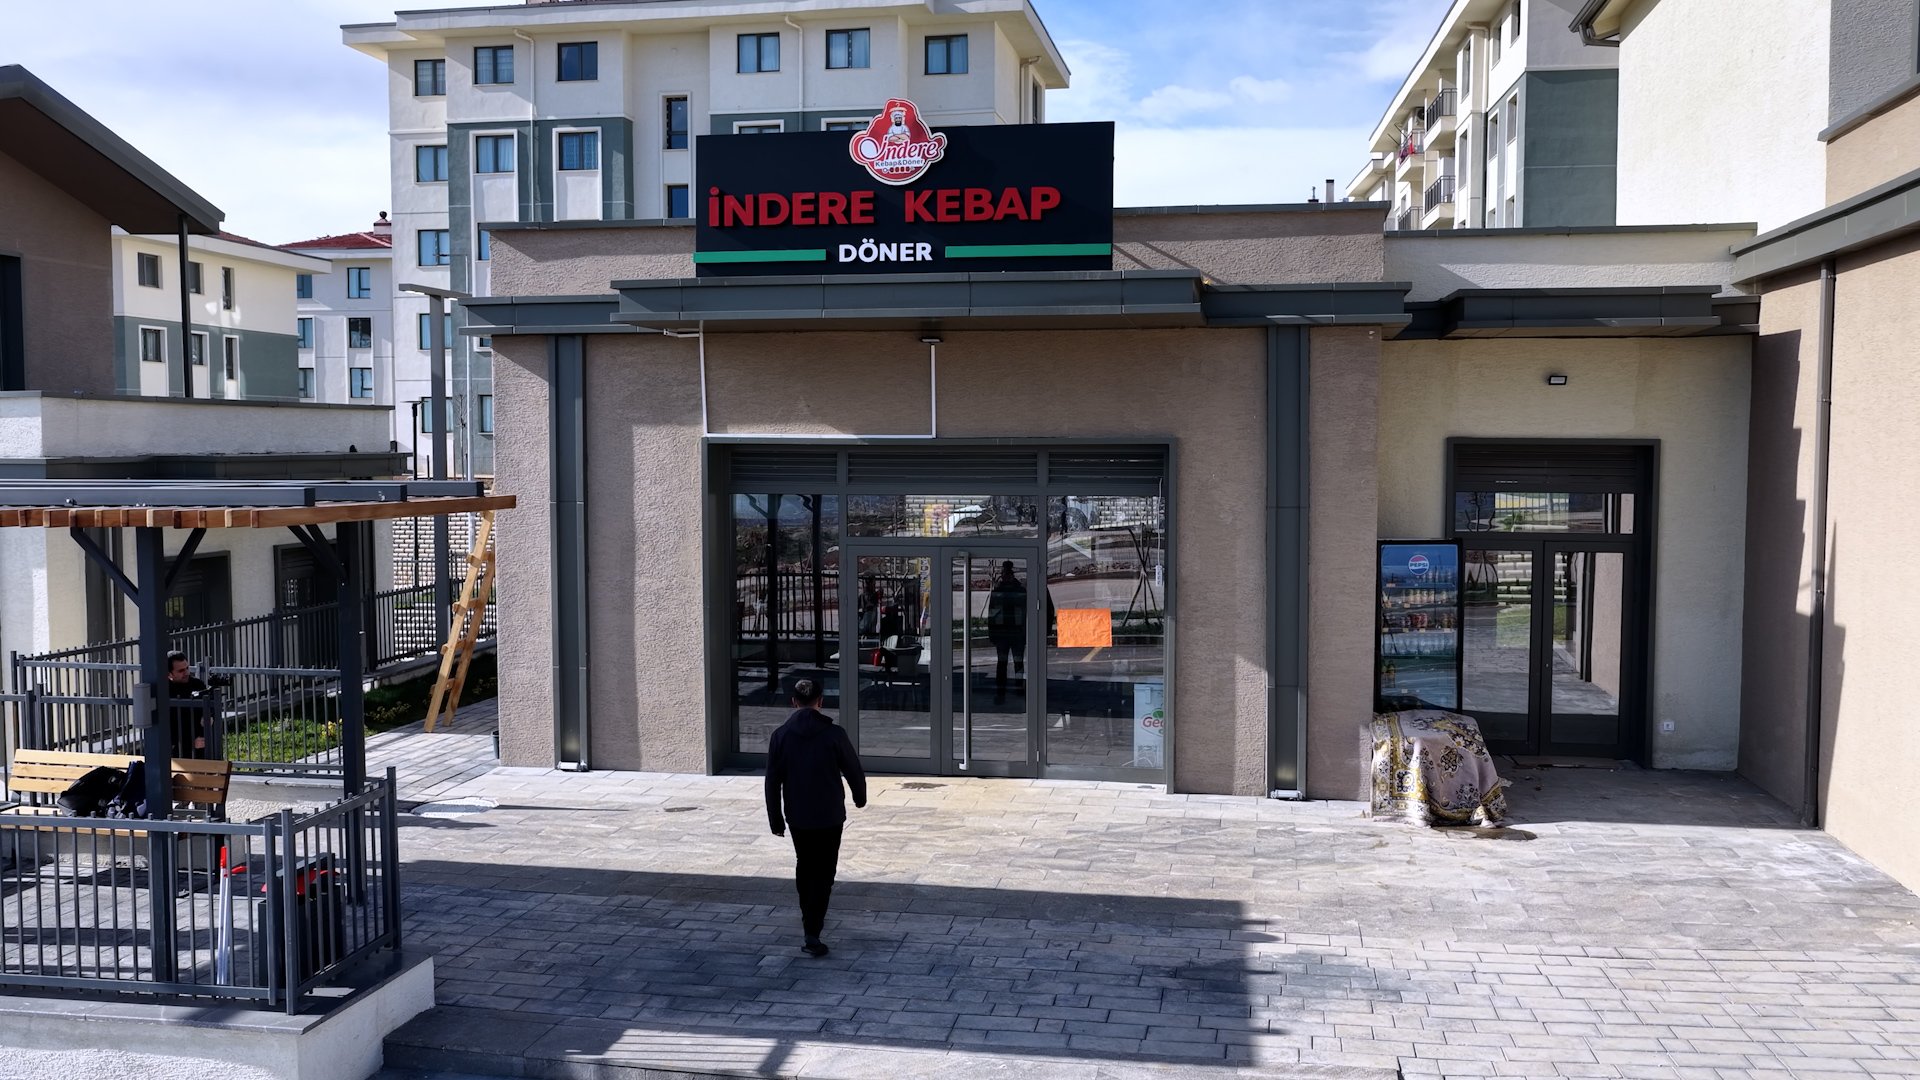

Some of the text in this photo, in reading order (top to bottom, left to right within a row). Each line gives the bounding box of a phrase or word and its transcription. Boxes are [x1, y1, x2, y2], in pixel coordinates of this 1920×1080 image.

[708, 186, 1061, 227] İNDERE KEBAP
[838, 238, 933, 263] DÖNER
